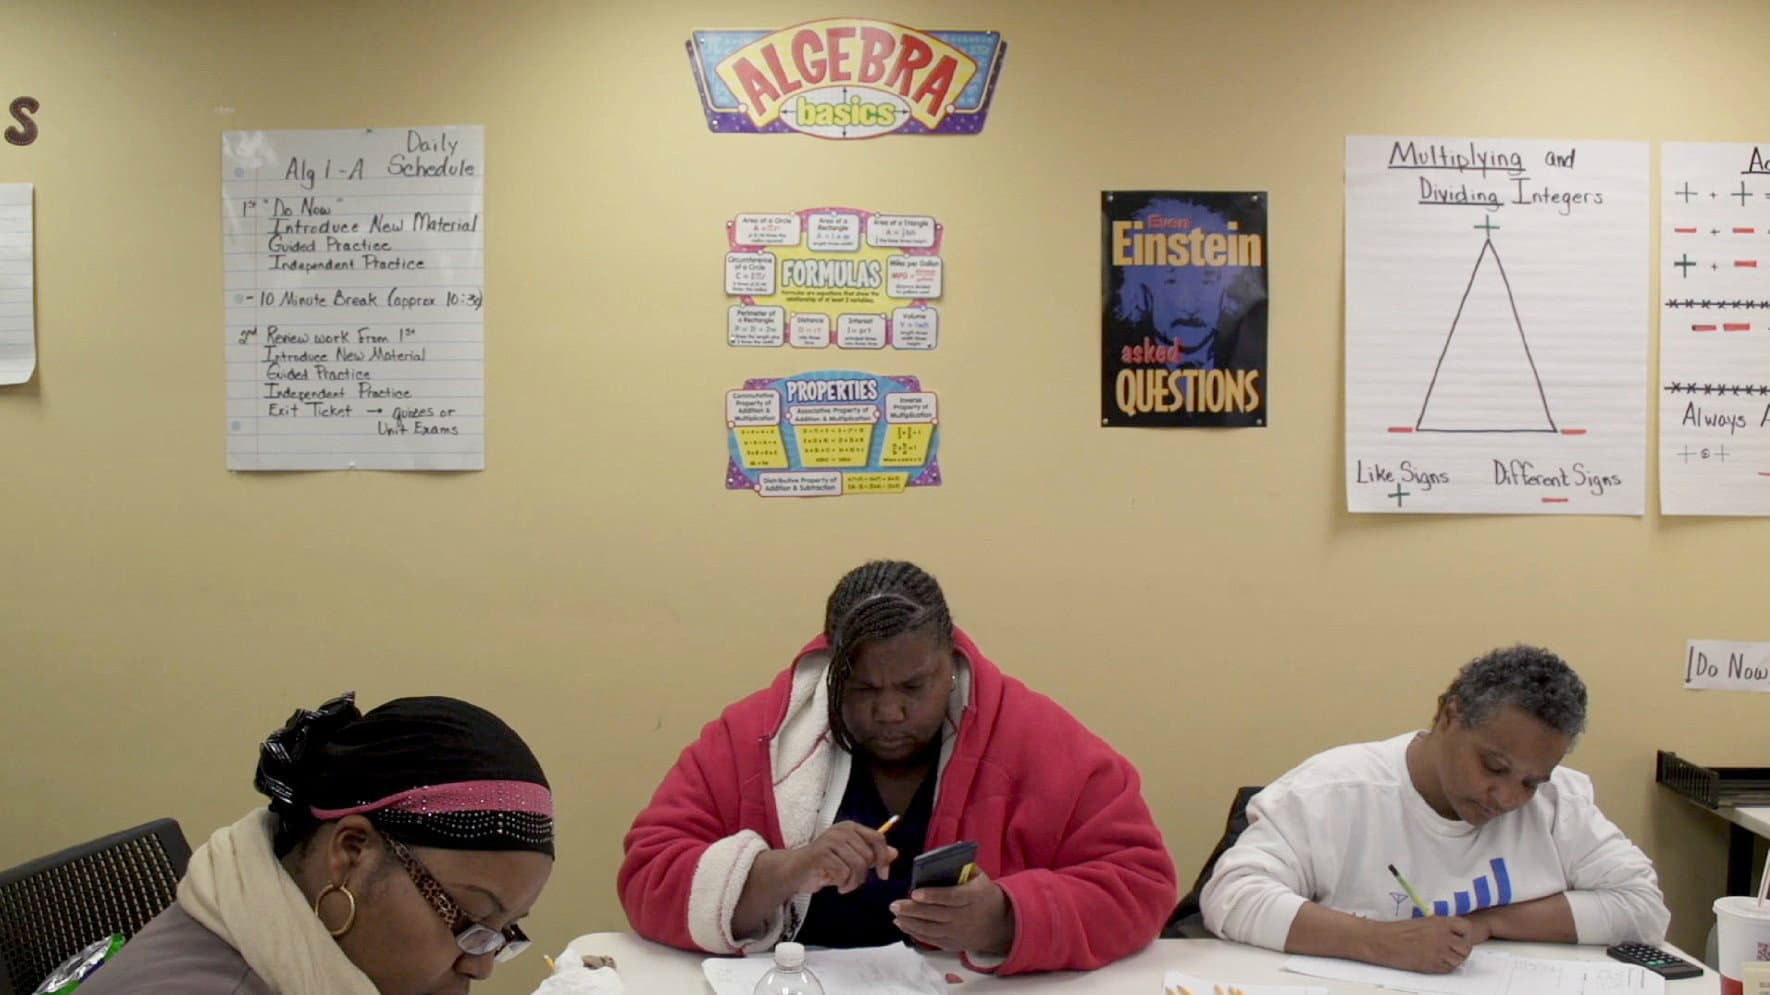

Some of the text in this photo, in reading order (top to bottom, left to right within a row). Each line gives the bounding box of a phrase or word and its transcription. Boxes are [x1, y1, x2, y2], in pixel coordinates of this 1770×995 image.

[731, 27, 957, 117] ALGEBRA
[797, 96, 896, 127] basics
[407, 129, 459, 156] Daily
[387, 154, 475, 178] Schedule
[1388, 141, 1576, 178] Multiplying and
[285, 157, 316, 190] Alg
[1419, 176, 1604, 216] Dividing Integers
[267, 212, 479, 234] Introduce New Material
[268, 233, 393, 253] Guided Practice
[1112, 220, 1262, 267] Einstein
[267, 254, 426, 275] Independent Practice
[782, 258, 882, 288] FORMULAS
[280, 291, 327, 307] Minute
[333, 289, 378, 307] Break
[266, 324, 310, 345] Review
[313, 329, 350, 345] work
[357, 326, 390, 345] From
[261, 345, 427, 364] Introduce New Material
[1121, 336, 1183, 364] asked
[266, 362, 371, 382] Guided Practice
[263, 381, 413, 402] Independent Practice
[786, 379, 878, 403] PROPERTIES
[1116, 368, 1261, 417] QUESTIONS
[268, 403, 299, 418] Exit
[304, 400, 353, 418] Ticket
[439, 408, 457, 418] or
[1682, 401, 1746, 435] Always
[378, 420, 459, 437] Unit Exams
[1356, 460, 1450, 491] Like Signs
[1493, 458, 1622, 496] Different Signs
